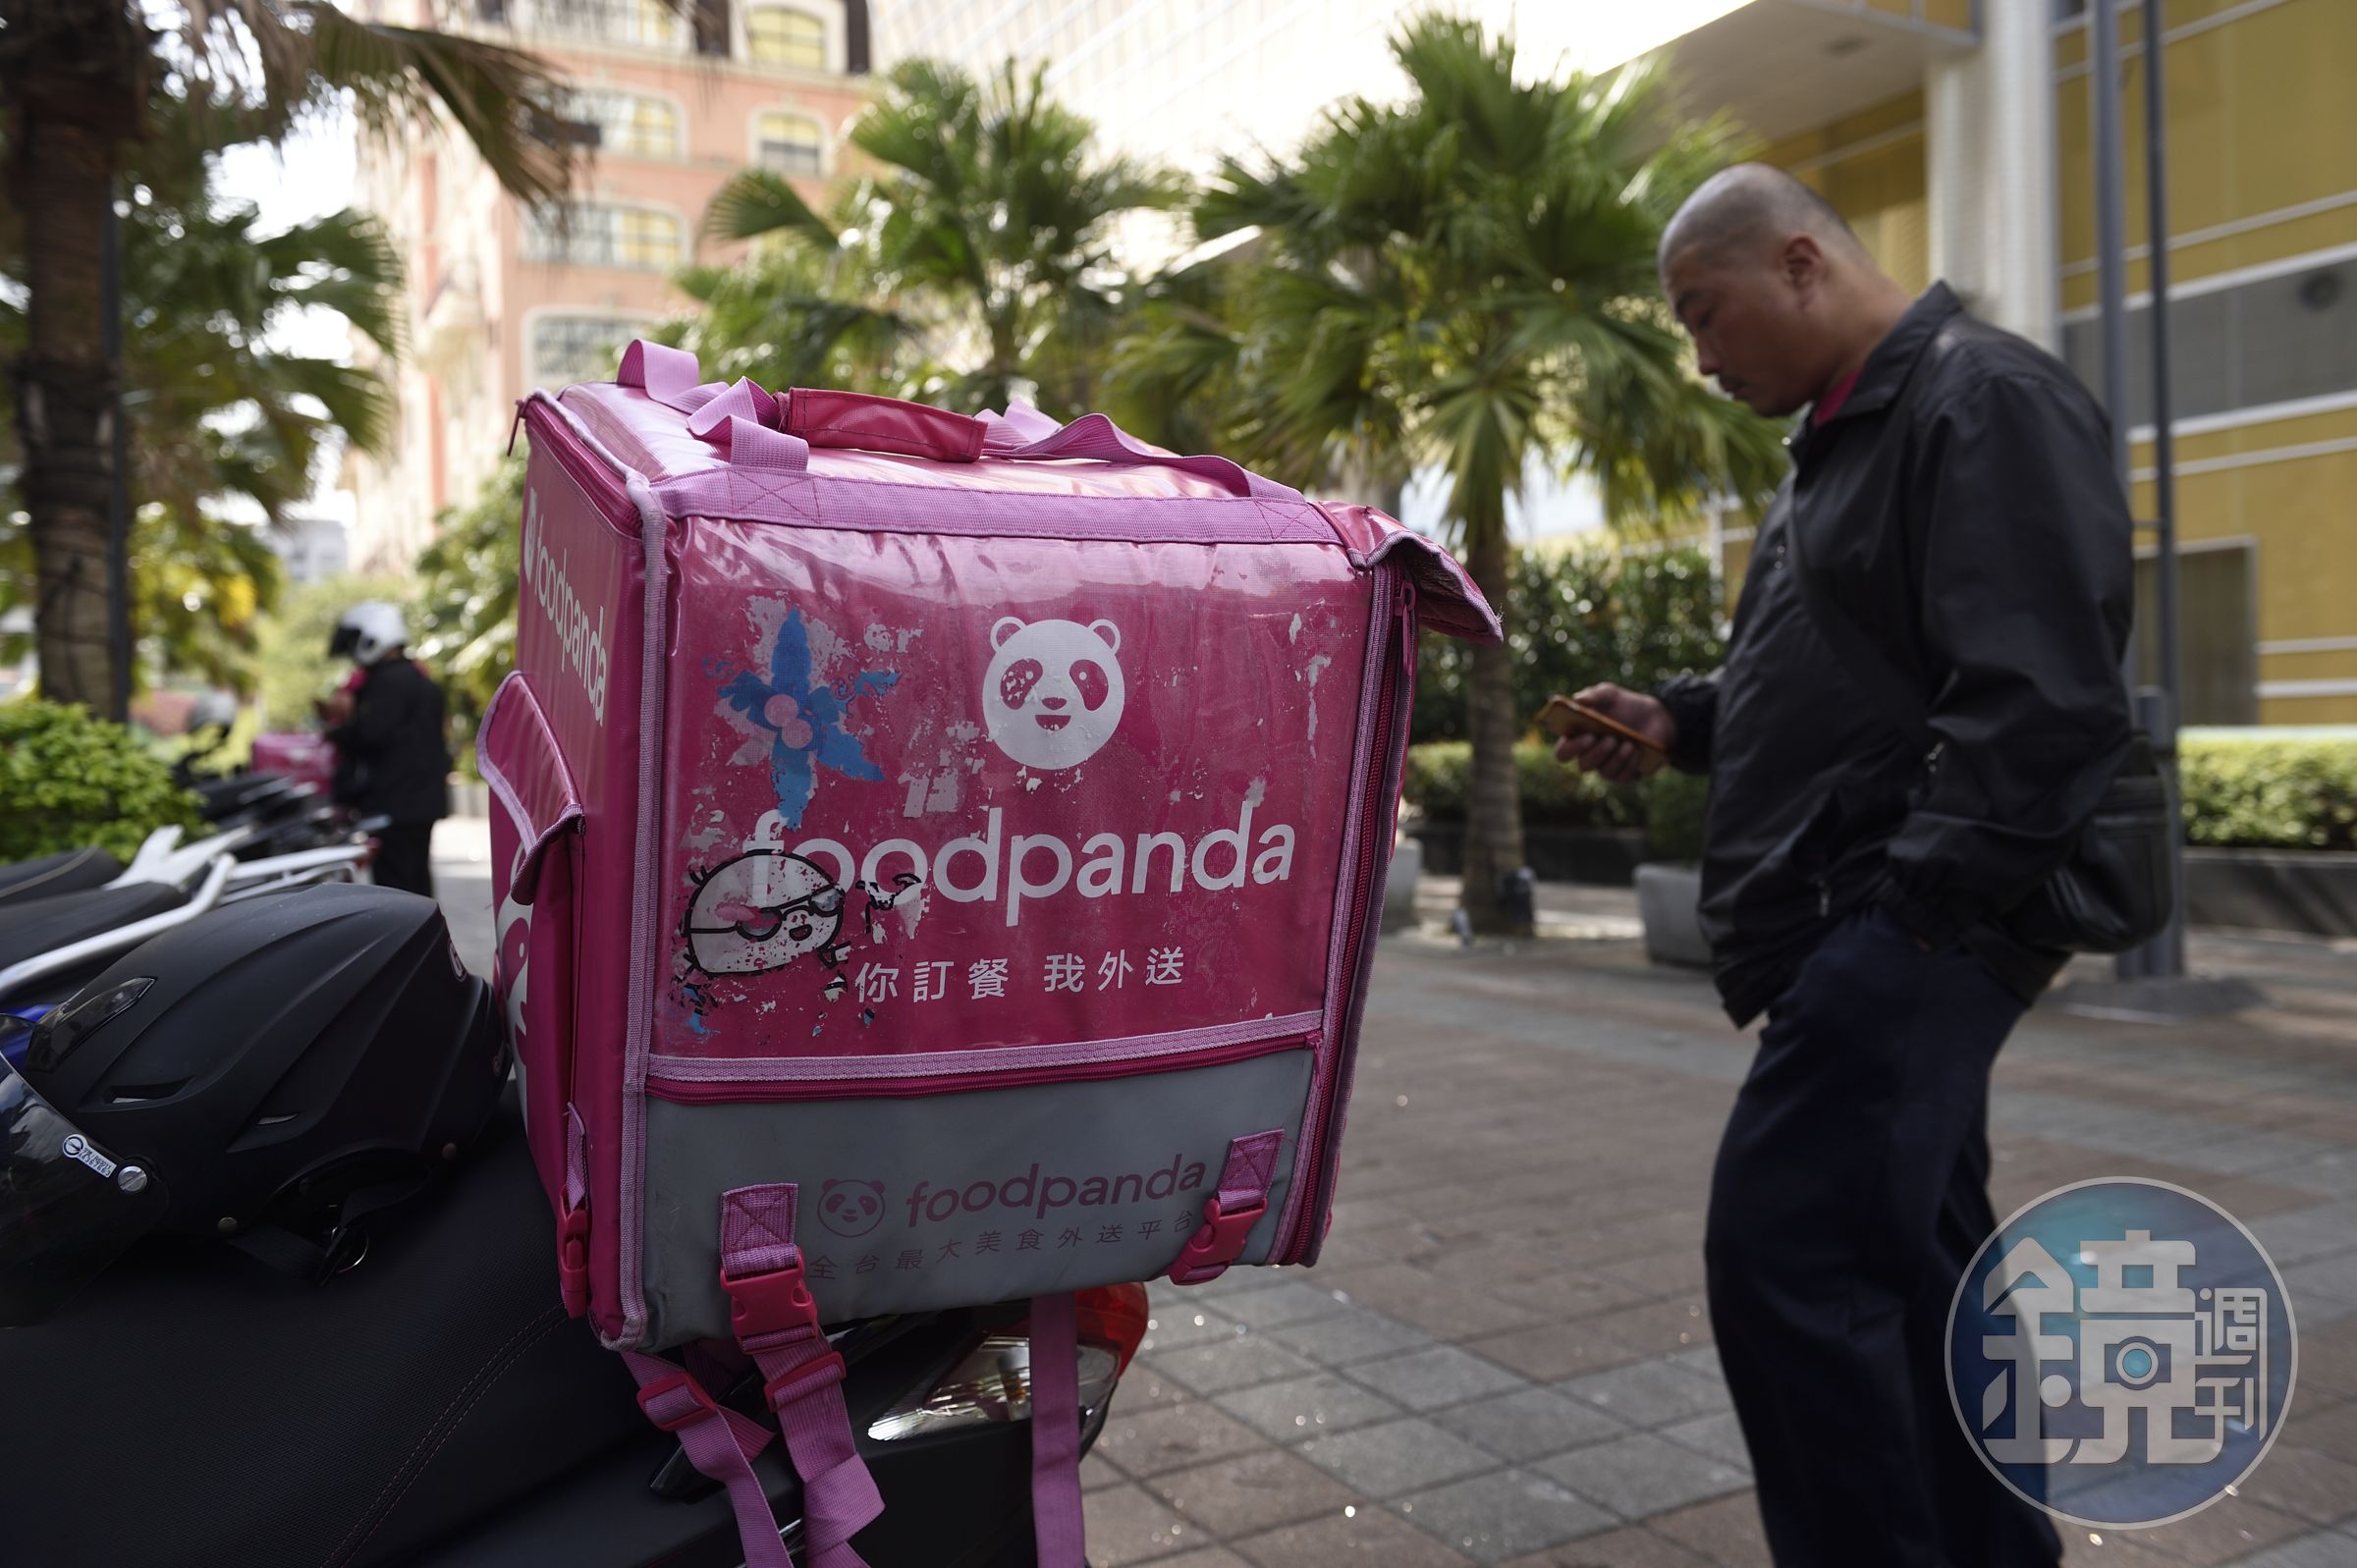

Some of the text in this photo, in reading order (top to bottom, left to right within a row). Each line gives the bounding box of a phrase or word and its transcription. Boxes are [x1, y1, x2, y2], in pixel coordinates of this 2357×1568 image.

[534, 513, 607, 729] foodpanda
[742, 800, 1296, 927] foodpanda
[854, 946, 1184, 1003] 你訂餐 我外送
[905, 1153, 1207, 1227] foodpanda
[808, 1210, 1195, 1280] 全台最大美食外送平台
